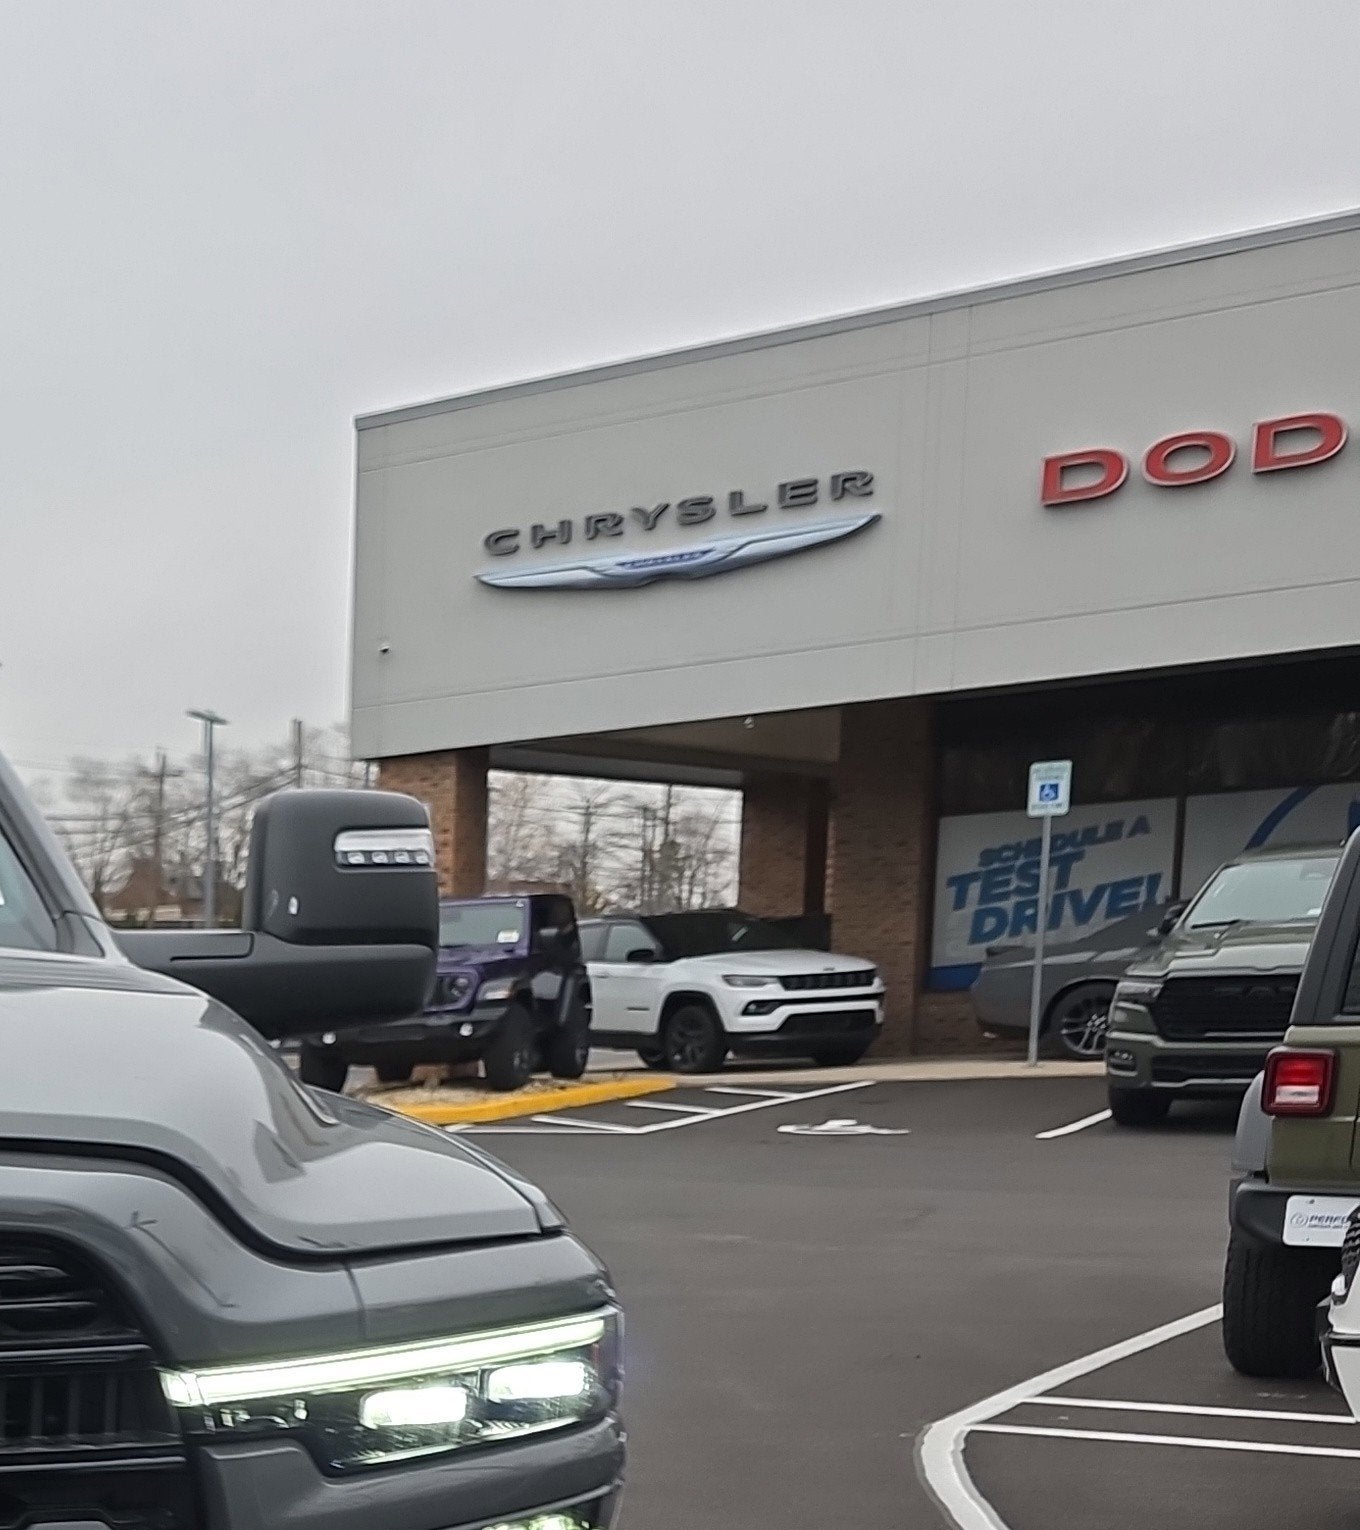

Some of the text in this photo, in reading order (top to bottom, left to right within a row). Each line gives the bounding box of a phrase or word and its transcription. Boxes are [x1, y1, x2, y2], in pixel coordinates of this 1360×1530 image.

[1041, 411, 1346, 507] DOD
[484, 469, 874, 556] CHRYSLER
[1127, 815, 1151, 838] A
[947, 850, 1086, 911] TEST
[968, 872, 1162, 945] DRIVE!
